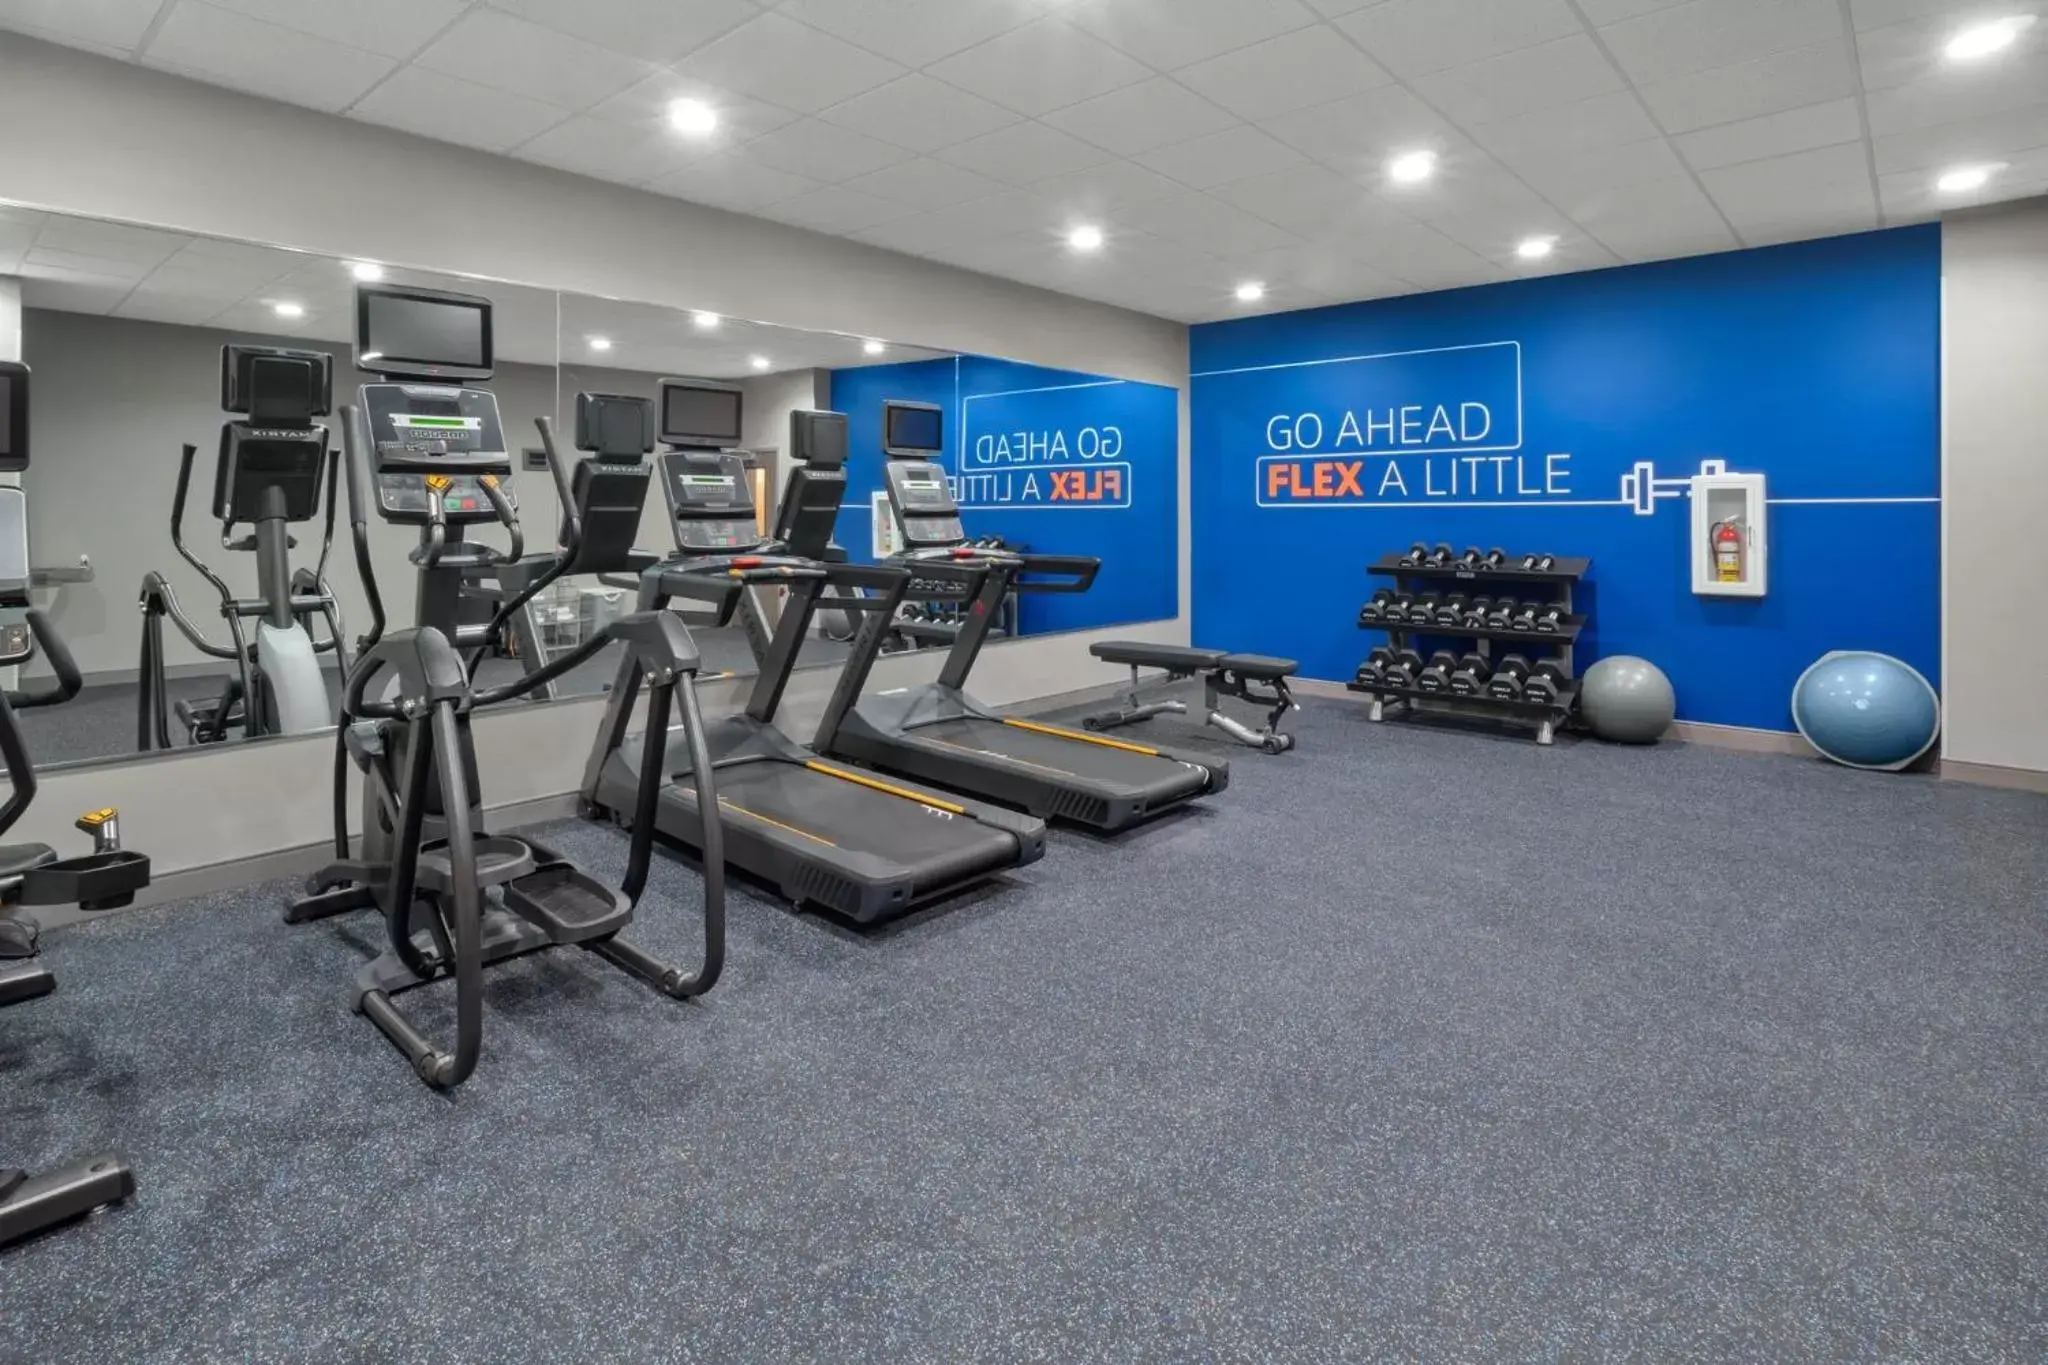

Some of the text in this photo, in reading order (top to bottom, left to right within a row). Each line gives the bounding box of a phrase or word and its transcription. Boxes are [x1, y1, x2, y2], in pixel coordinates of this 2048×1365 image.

[1266, 402, 1491, 450] GO AHEAD
[1268, 453, 1571, 497] FLEX A LITTLE
